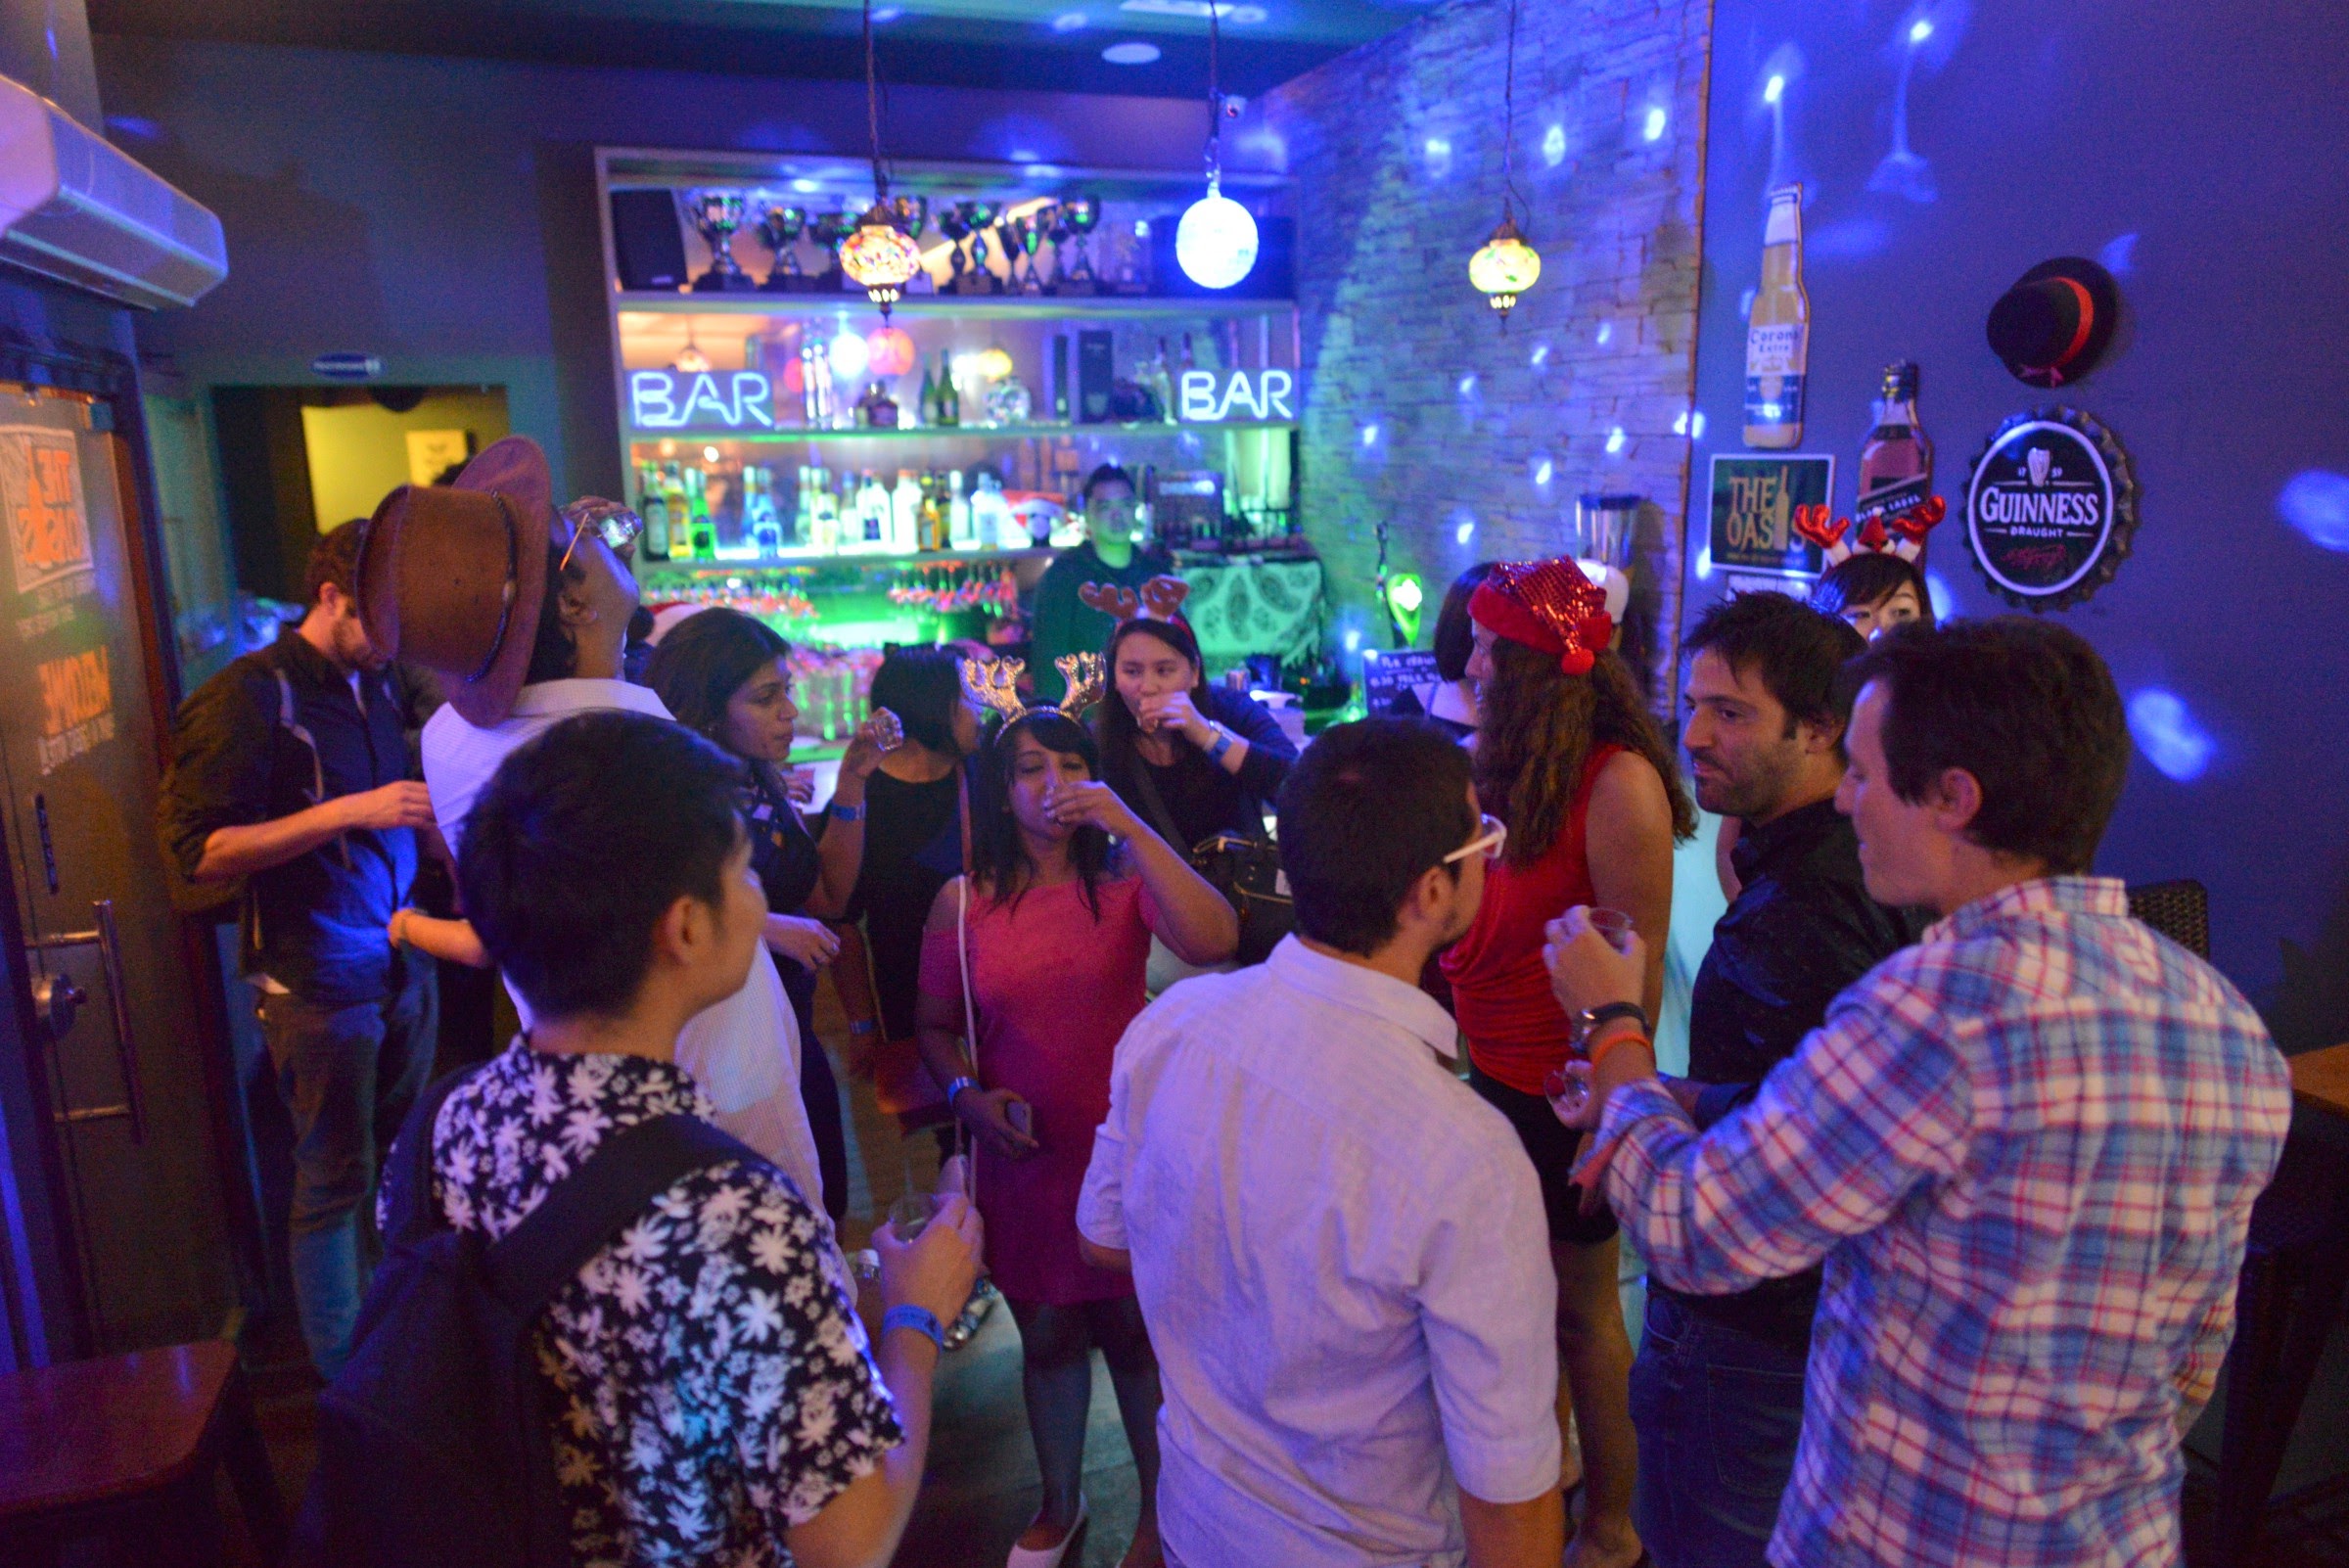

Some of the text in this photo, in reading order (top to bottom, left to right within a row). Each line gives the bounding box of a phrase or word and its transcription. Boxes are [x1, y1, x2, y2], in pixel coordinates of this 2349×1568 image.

[631, 371, 772, 428] BAR
[1181, 370, 1293, 421] BAR
[1727, 476, 1777, 514] THE
[1979, 485, 2100, 527] GUINNESS
[2009, 525, 2064, 538] DRAUGHT
